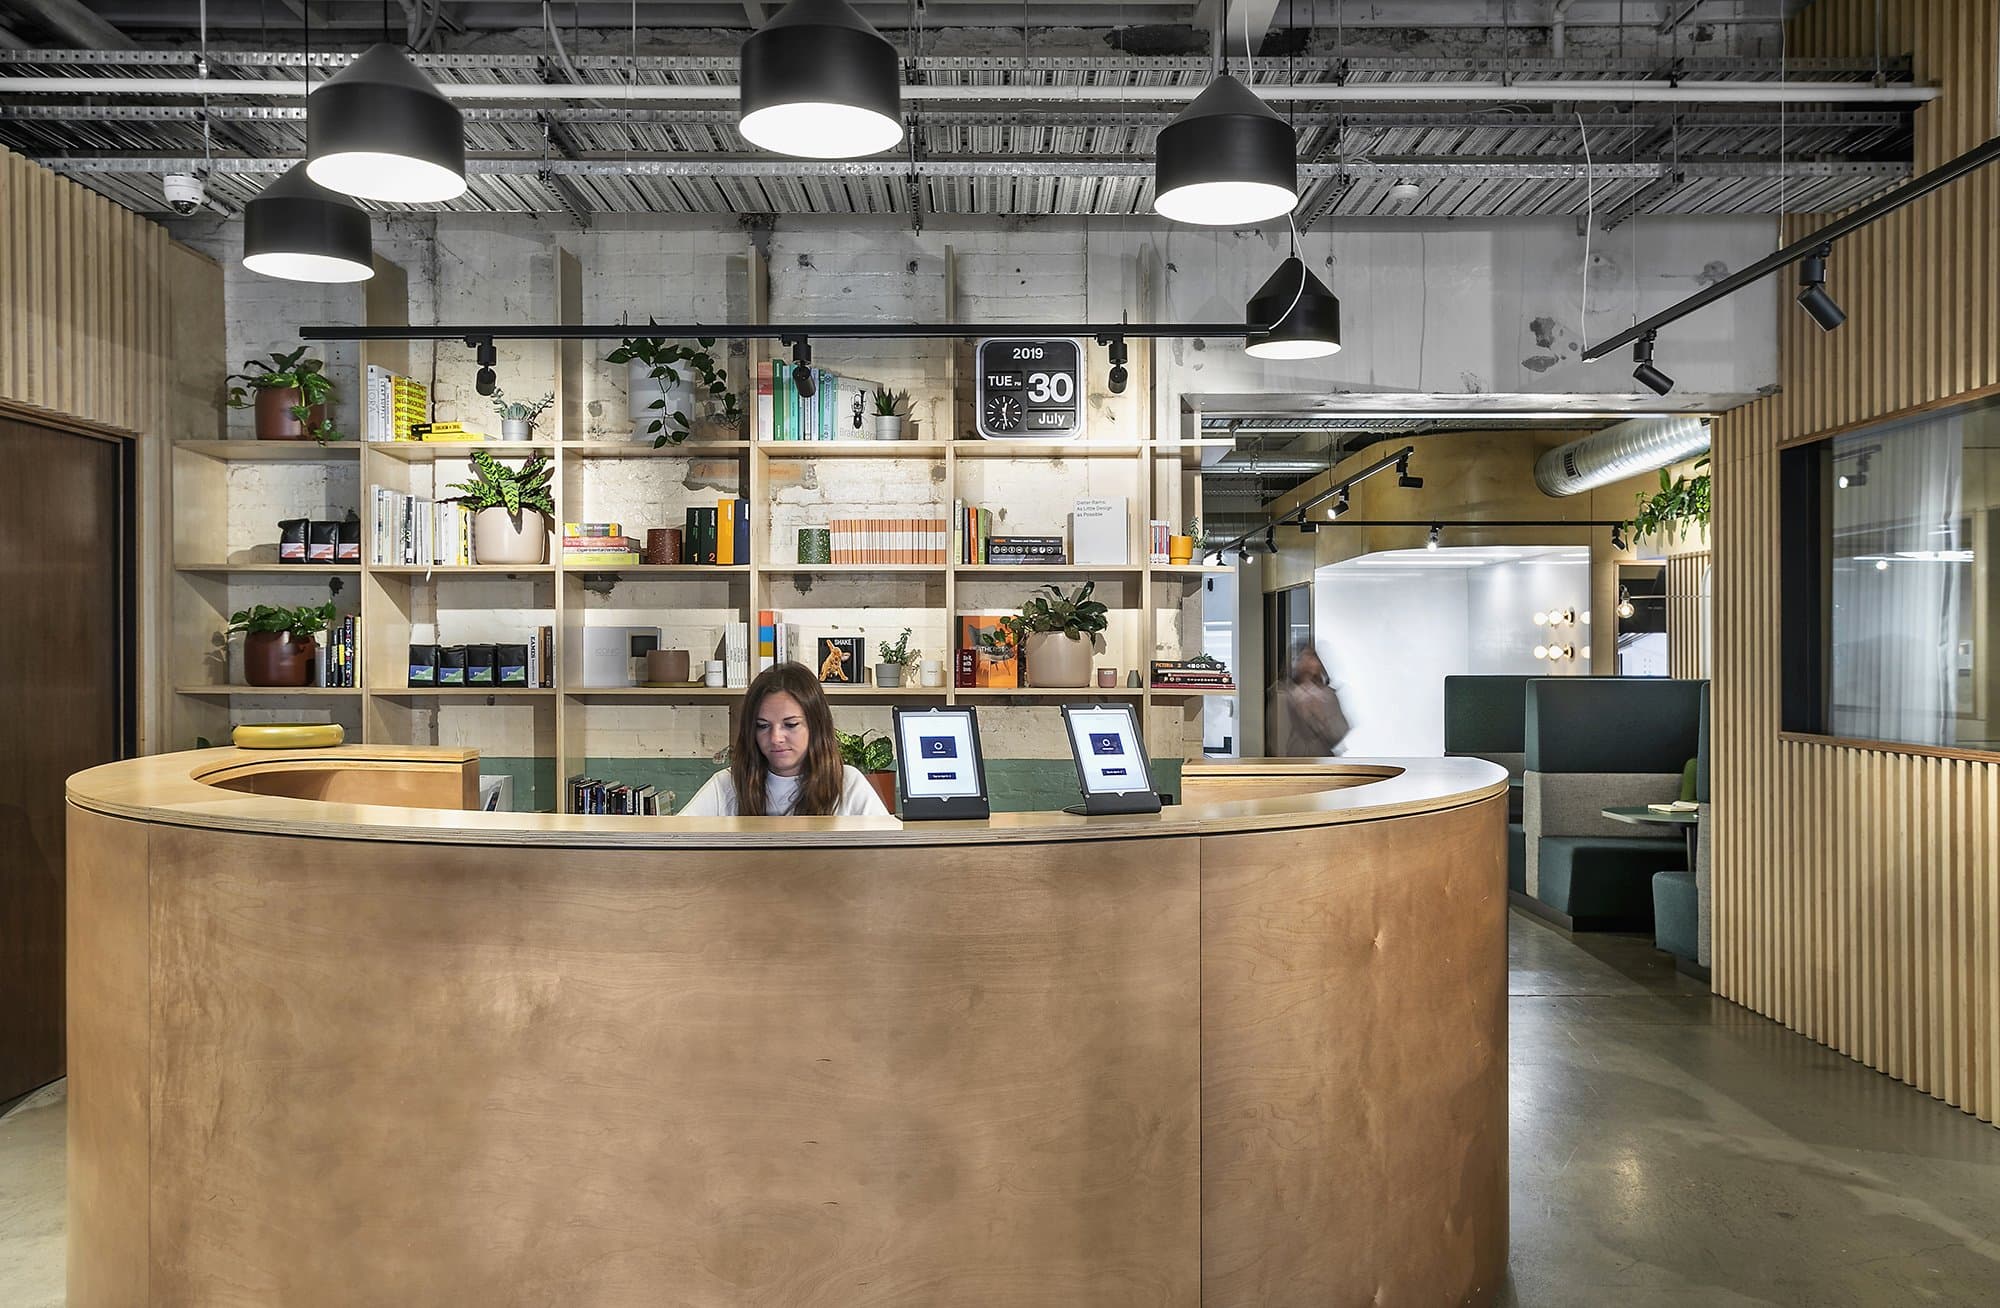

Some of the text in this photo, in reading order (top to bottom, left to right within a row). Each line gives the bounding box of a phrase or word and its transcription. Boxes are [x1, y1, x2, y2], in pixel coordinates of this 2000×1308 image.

[1012, 347, 1044, 360] 2019
[987, 375, 1013, 387] TUE
[1027, 372, 1074, 403] 30
[1038, 412, 1065, 427] July
[692, 552, 698, 562] 1
[708, 552, 716, 562] 2
